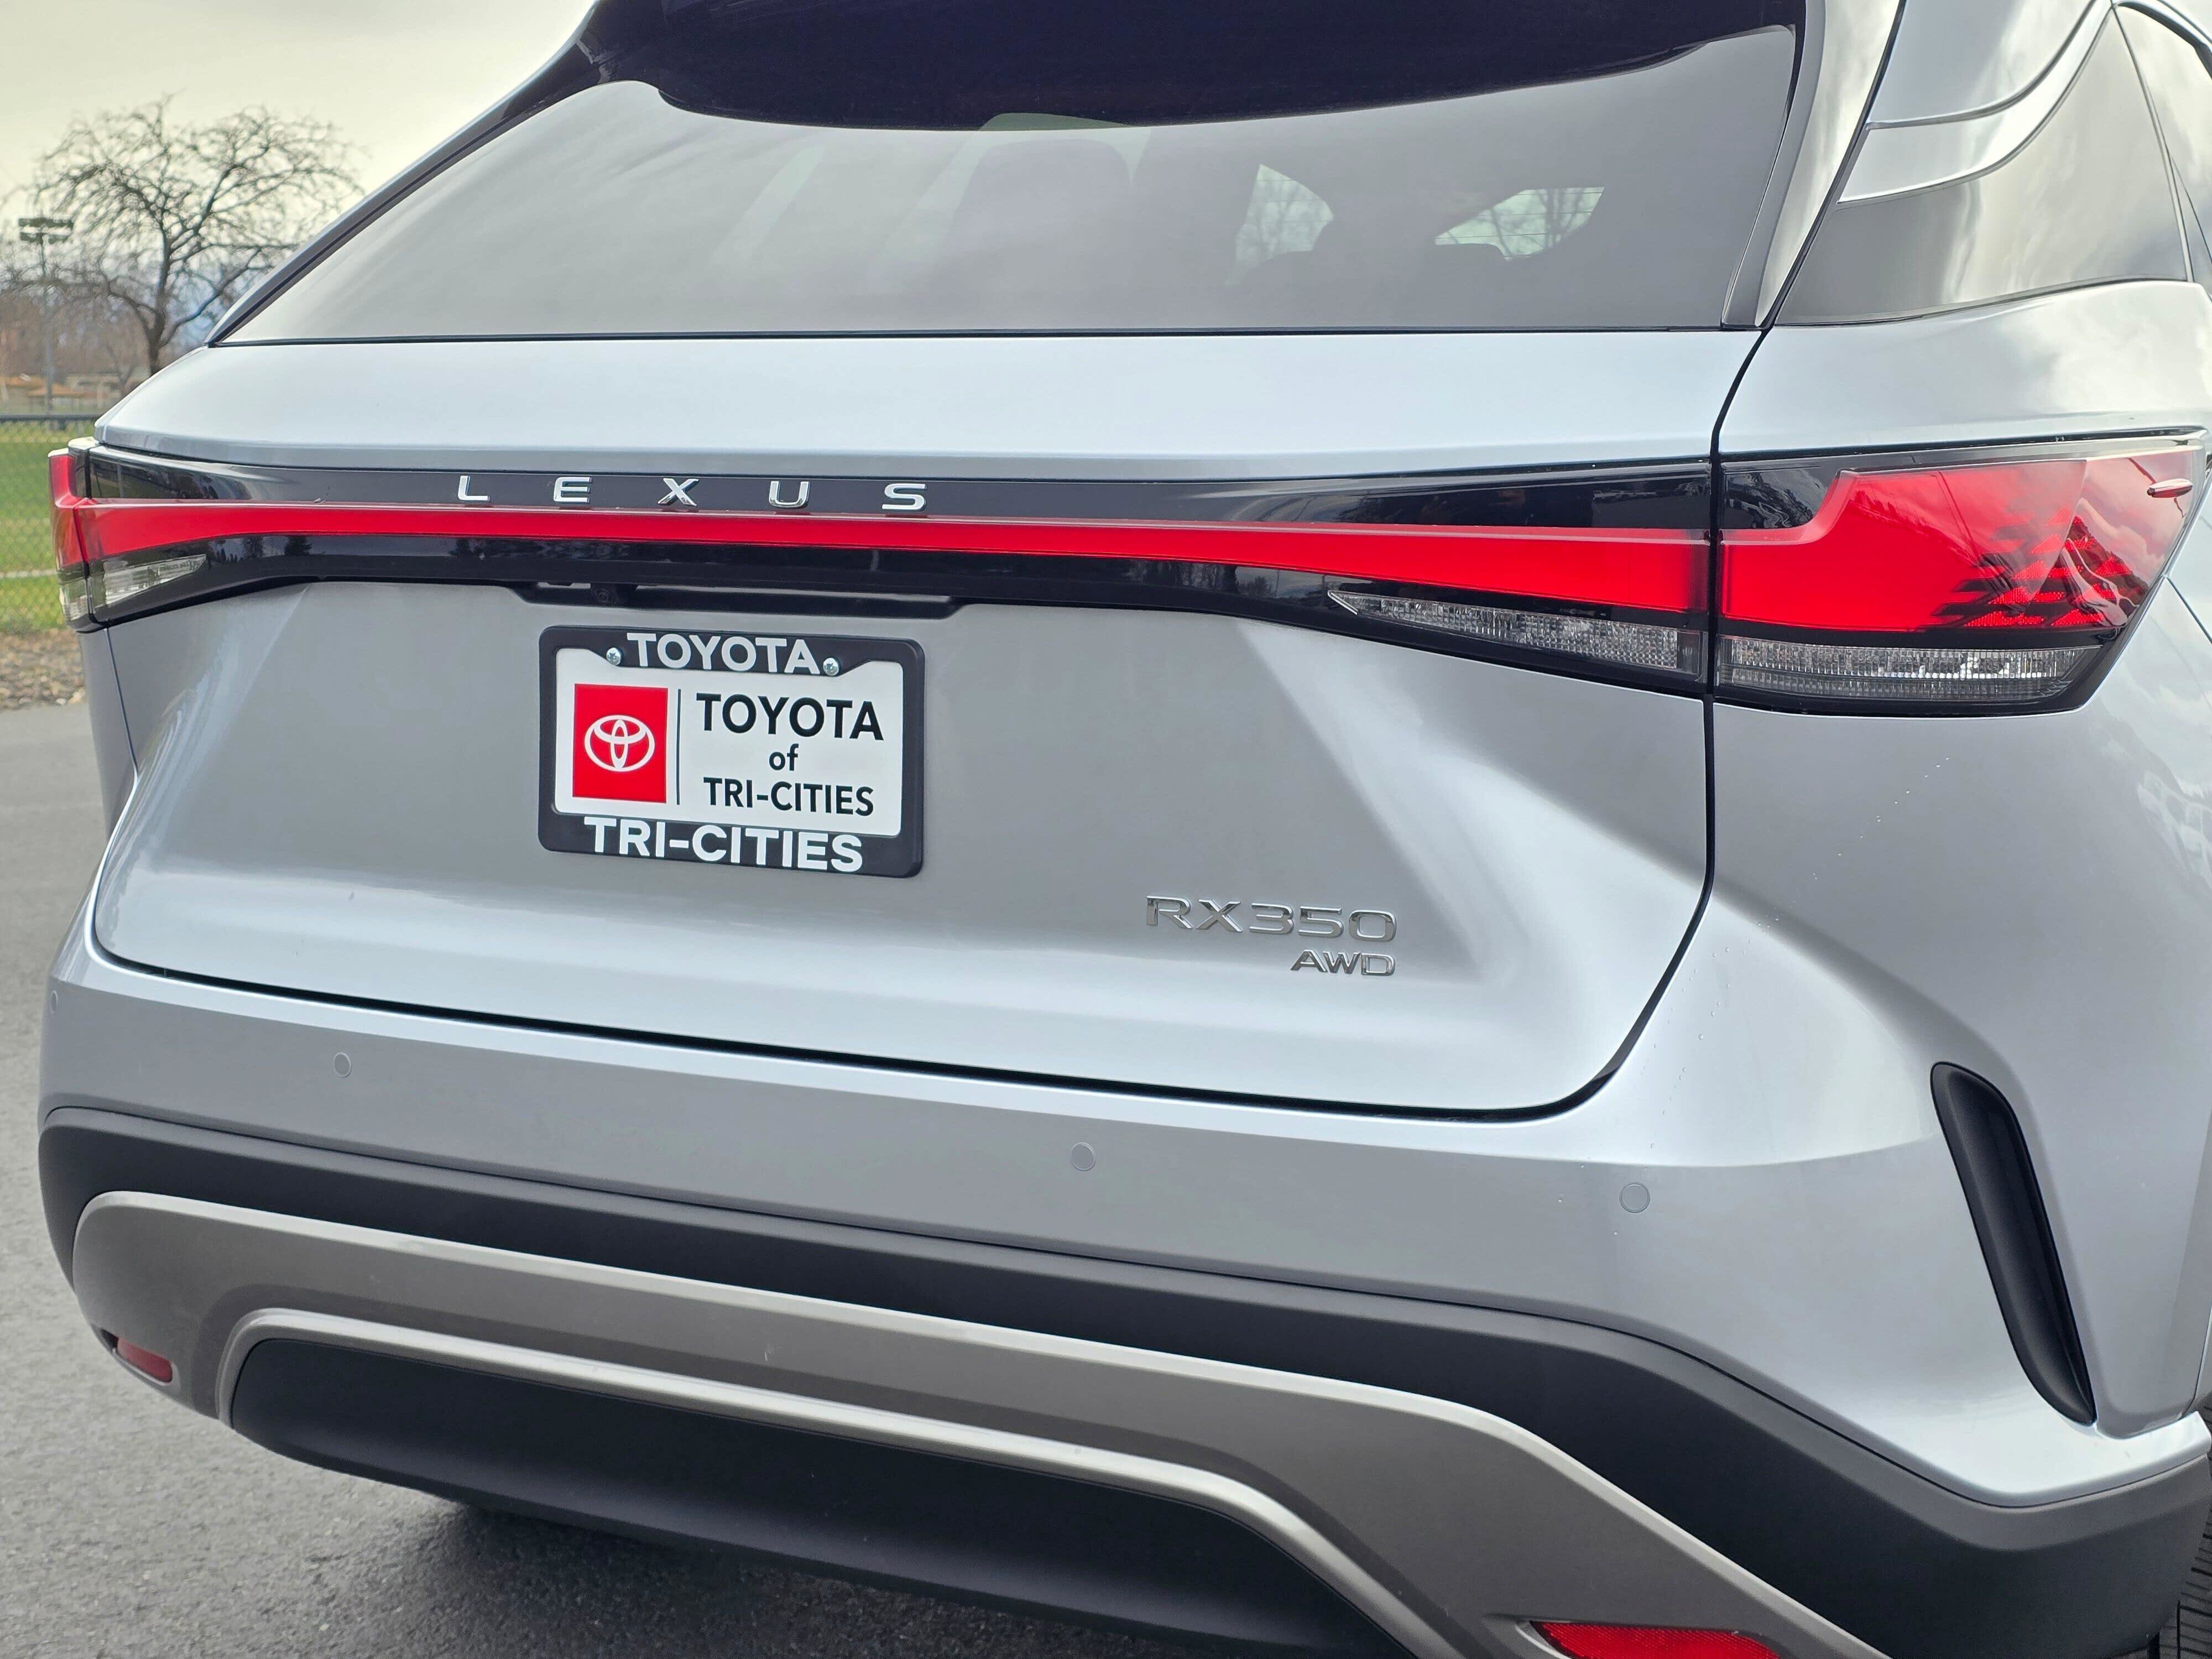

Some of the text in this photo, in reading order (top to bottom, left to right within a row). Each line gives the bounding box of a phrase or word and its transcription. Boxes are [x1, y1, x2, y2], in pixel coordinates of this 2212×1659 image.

[457, 475, 927, 511] LEXUS
[627, 633, 821, 675] TOYOTA
[696, 692, 884, 741] TOYOTA
[769, 744, 799, 771] of
[703, 777, 874, 817] TRI-CITIES
[583, 816, 863, 872] TRI-CITIES
[1290, 949, 1396, 977] AWD
